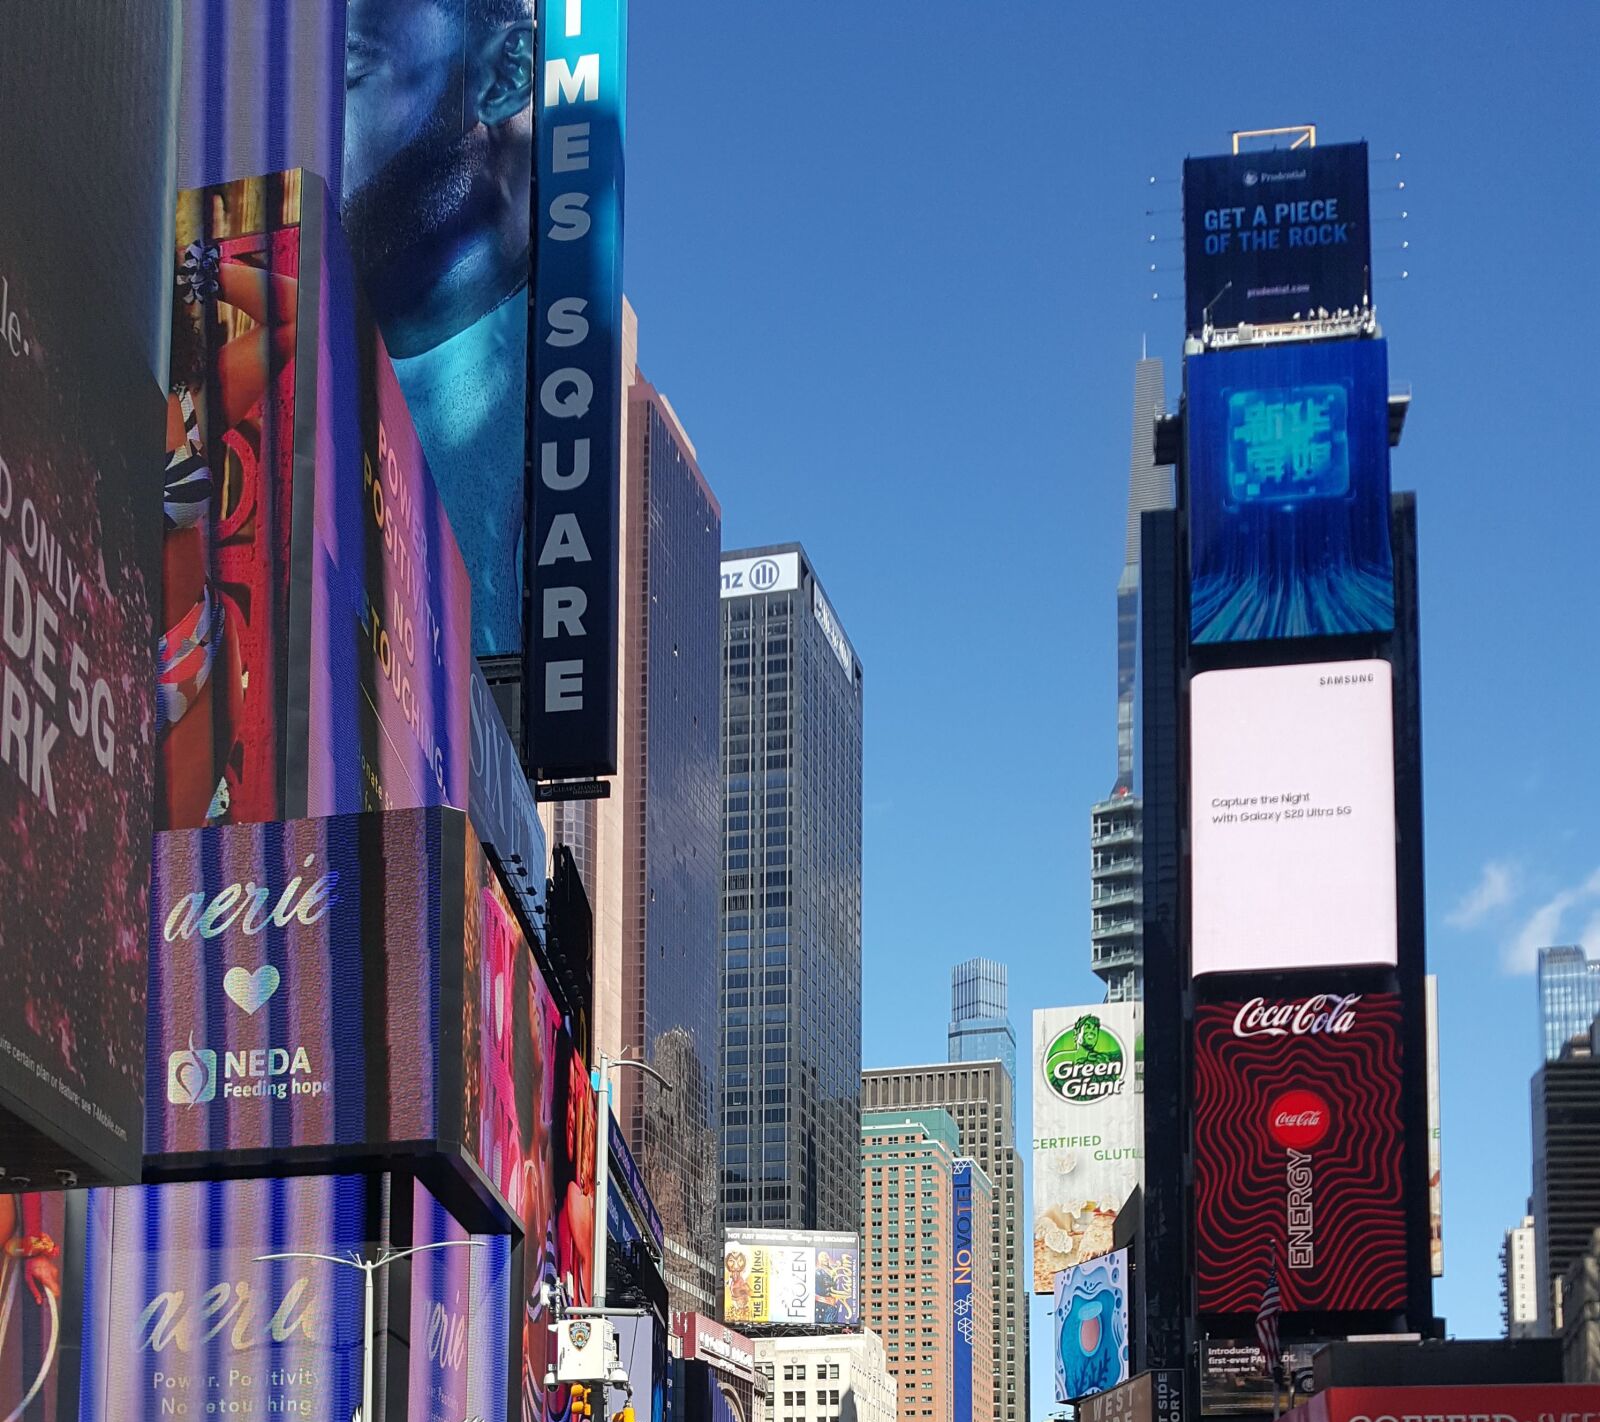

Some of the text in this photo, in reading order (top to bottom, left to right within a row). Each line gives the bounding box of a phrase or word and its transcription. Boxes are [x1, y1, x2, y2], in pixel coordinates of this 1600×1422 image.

[1261, 170, 1306, 182] Prudential
[1204, 198, 1339, 231] GET A PIECE
[1204, 223, 1349, 255] OF THE ROCK
[538, 297, 593, 713] SQUARE
[21, 498, 80, 616] ONLY
[393, 589, 415, 667] NO
[360, 592, 447, 798] TOUCHING.
[1319, 673, 1375, 687] SAMSUNG
[68, 642, 115, 777] 5G
[0, 665, 57, 817] RK
[1211, 792, 1310, 809] Capture the Night
[1211, 805, 1352, 824] with Galaxy S20 Ultra 5G
[164, 853, 340, 942] aerie
[1233, 993, 1362, 1037] Coca-Cola
[224, 1047, 312, 1078] NEDA
[1053, 1061, 1121, 1079] Green
[12, 1046, 36, 1072] certain
[36, 1063, 50, 1083] plan
[50, 1075, 58, 1089] or
[81, 1098, 92, 1115] see
[92, 1102, 128, 1142] T-Mobile.com
[223, 1078, 331, 1099] Feeding hope
[1062, 1077, 1124, 1098] Giant
[1033, 1135, 1102, 1150] CERTIFIED
[1287, 1148, 1314, 1269] ENERGY
[953, 1173, 972, 1284] NOVOTEL
[751, 1250, 764, 1318] THE LION KING
[787, 1251, 809, 1317] FROZEN
[1208, 1346, 1260, 1356] Introducing
[1208, 1356, 1249, 1365] first-ever
[161, 1397, 188, 1416] No
[1093, 1384, 1136, 1421] WEST
[1158, 1373, 1168, 1409] SIDE
